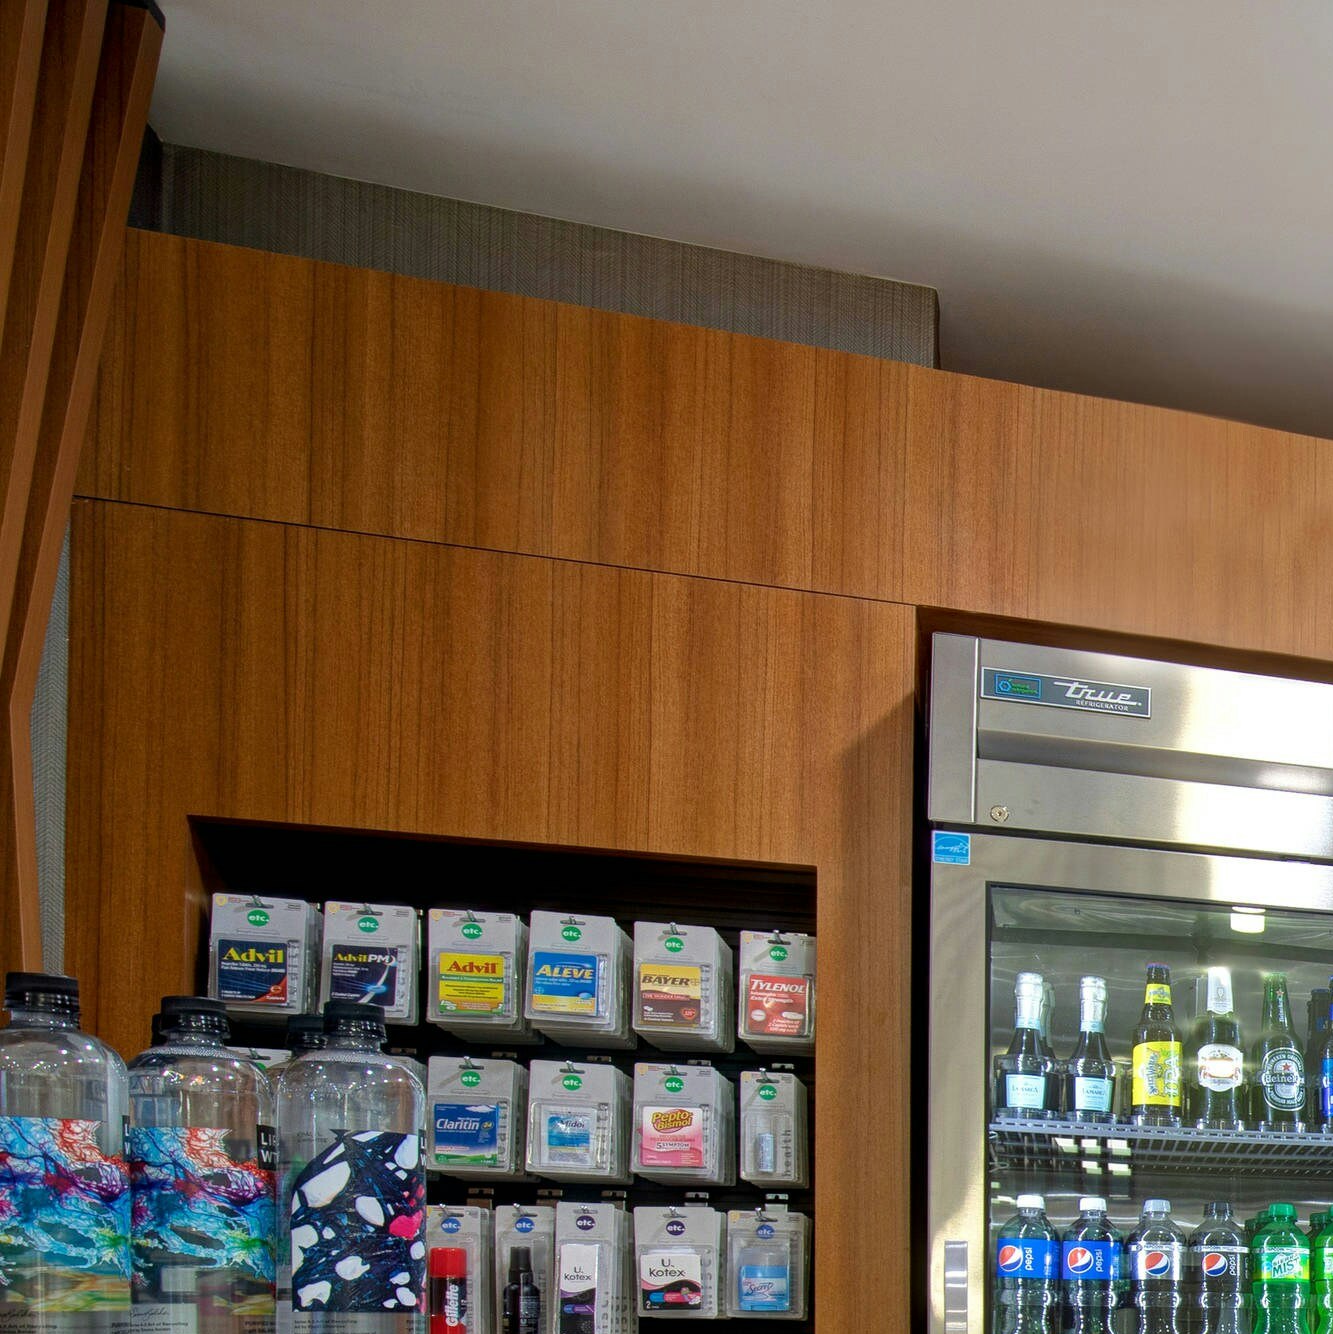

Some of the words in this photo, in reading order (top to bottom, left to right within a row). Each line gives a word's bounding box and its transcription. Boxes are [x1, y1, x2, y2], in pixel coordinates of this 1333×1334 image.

[1075, 699, 1128, 712] REFRIGERATOR
[221, 948, 284, 963] Advil
[334, 953, 367, 963] Advil
[367, 954, 389, 964] PM
[447, 960, 498, 975] Advil
[536, 964, 594, 980] ALEVE
[641, 975, 690, 987] BAYER
[750, 979, 806, 994] TYLENOL
[436, 1118, 480, 1131] Claritin
[652, 1111, 693, 1125] Pepto-
[656, 1117, 692, 1132] Bismol
[1095, 1249, 1103, 1272] pepsi
[1229, 1254, 1237, 1277] pepsi
[564, 1271, 592, 1282] Kotex
[649, 1266, 685, 1280] Kotex
[445, 1283, 460, 1327] Gillette
